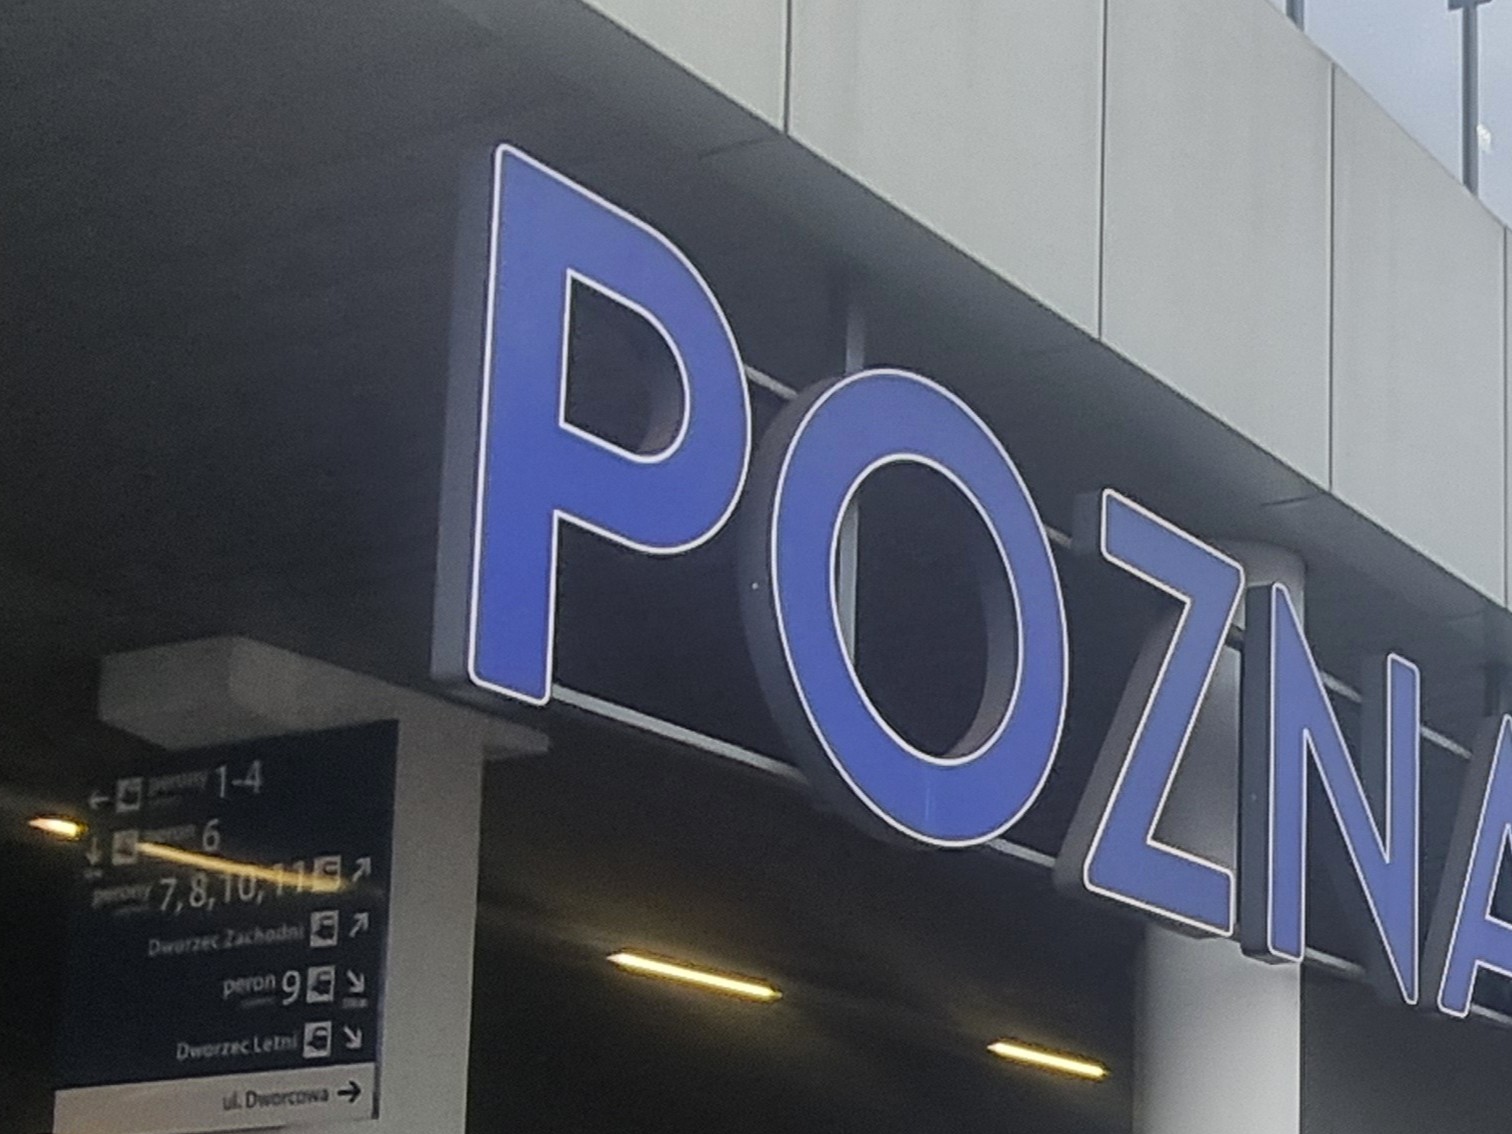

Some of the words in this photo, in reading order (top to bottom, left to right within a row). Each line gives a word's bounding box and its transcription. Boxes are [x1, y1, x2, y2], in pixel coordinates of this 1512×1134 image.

[215, 759, 263, 799] 1-4
[202, 818, 220, 851] 6
[148, 936, 219, 957] Dworzec
[222, 972, 277, 1000] peron
[281, 969, 301, 1006] 9
[176, 1040, 249, 1062] Dworzec
[252, 1033, 299, 1054] Letni
[222, 1090, 242, 1111] ul.
[245, 1087, 330, 1109] Dworcowa
